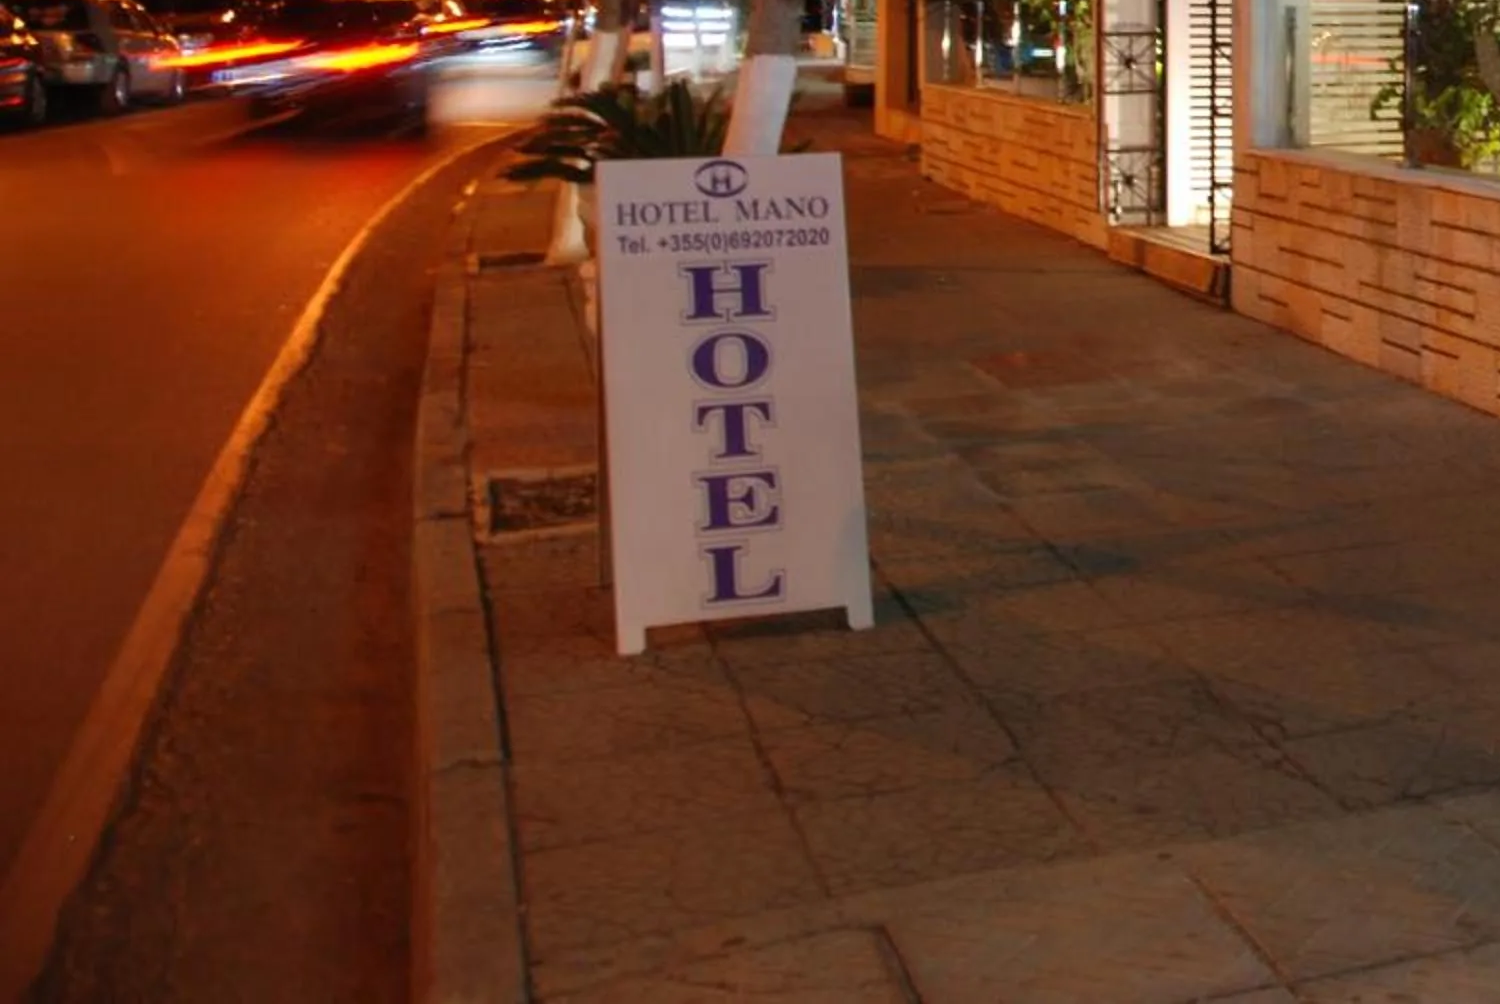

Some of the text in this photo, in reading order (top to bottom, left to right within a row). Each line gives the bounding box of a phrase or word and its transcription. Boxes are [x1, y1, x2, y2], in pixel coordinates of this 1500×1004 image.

[616, 196, 829, 226] HOTEL MANO
[617, 234, 651, 254] Tel.
[682, 262, 783, 604] HOTEL
